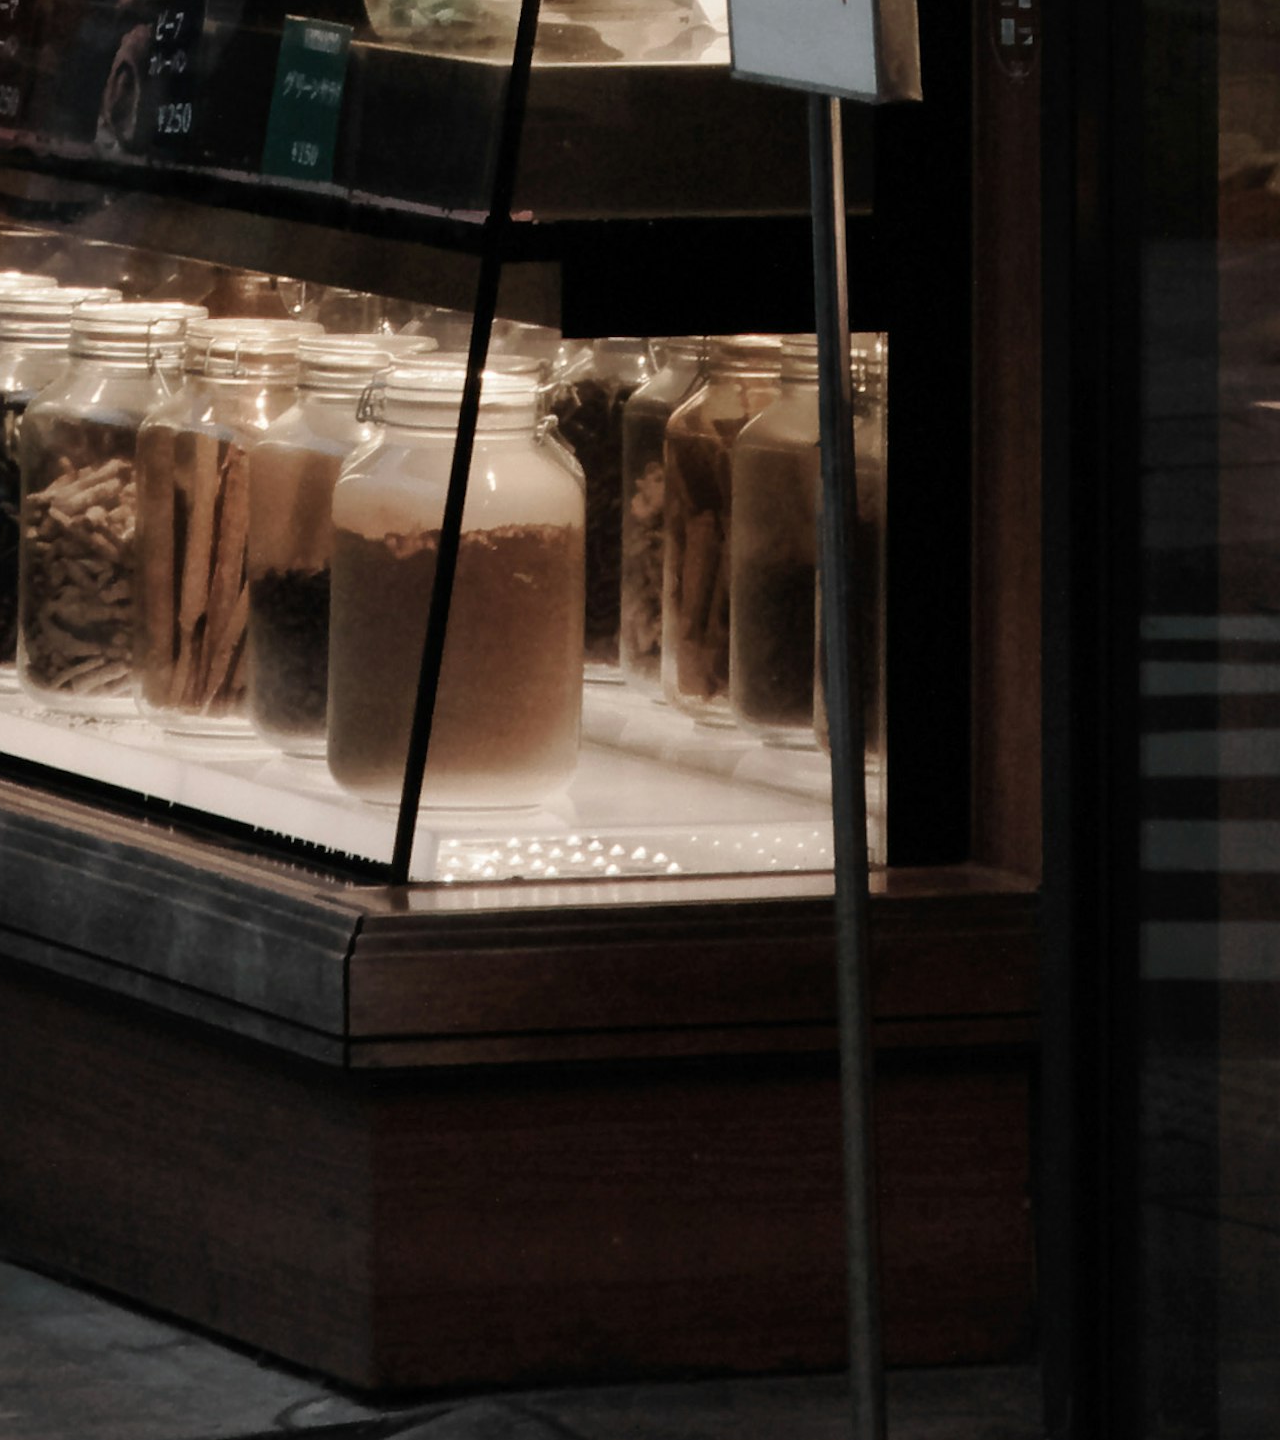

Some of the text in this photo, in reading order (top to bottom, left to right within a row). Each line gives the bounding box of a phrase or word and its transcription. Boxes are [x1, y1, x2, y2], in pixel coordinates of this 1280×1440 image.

[154, 8, 186, 43] ビーフ
[156, 101, 194, 135] ¥250
[290, 140, 320, 167] ¥150
